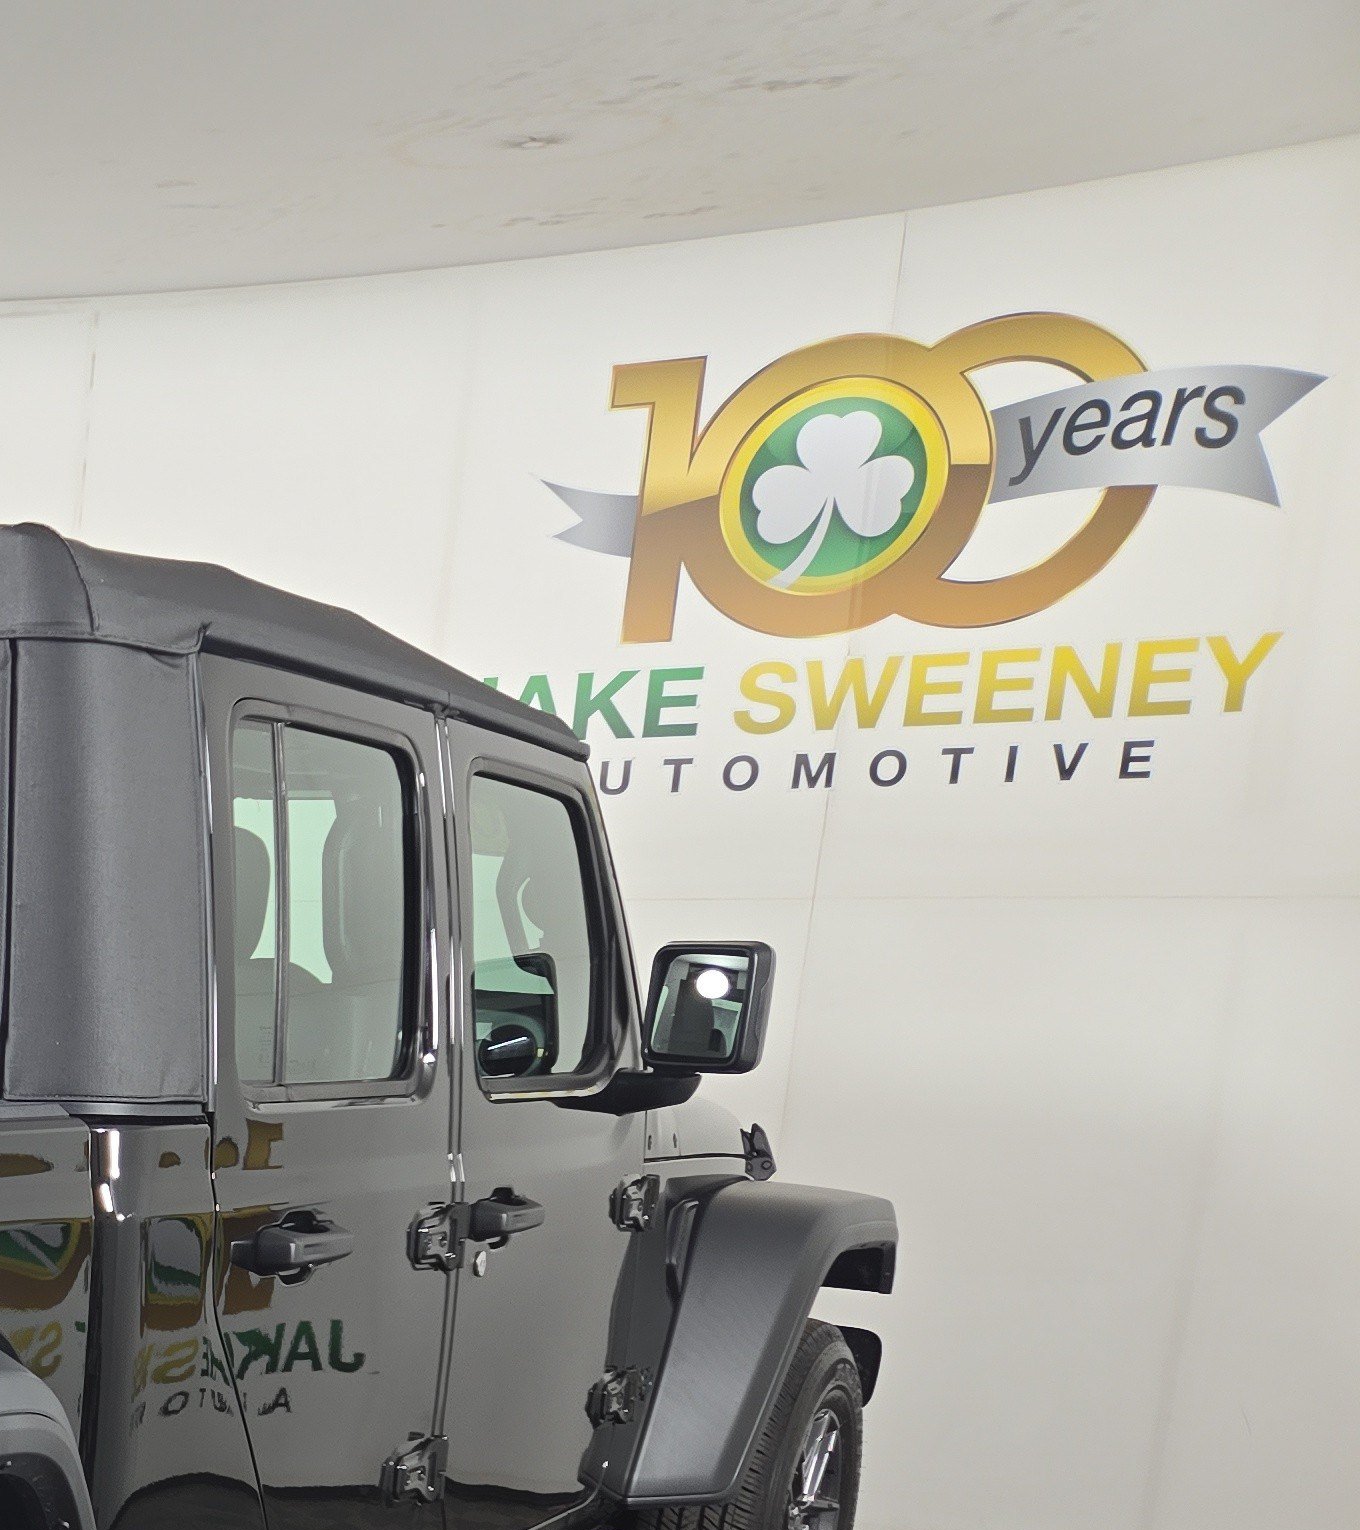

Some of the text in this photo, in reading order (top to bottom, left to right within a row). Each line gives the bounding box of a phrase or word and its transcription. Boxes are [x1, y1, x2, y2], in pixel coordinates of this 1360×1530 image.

[1007, 383, 1247, 487] years
[732, 631, 1284, 736] SWEENEY
[598, 739, 1156, 796] UTOMOTIVE
